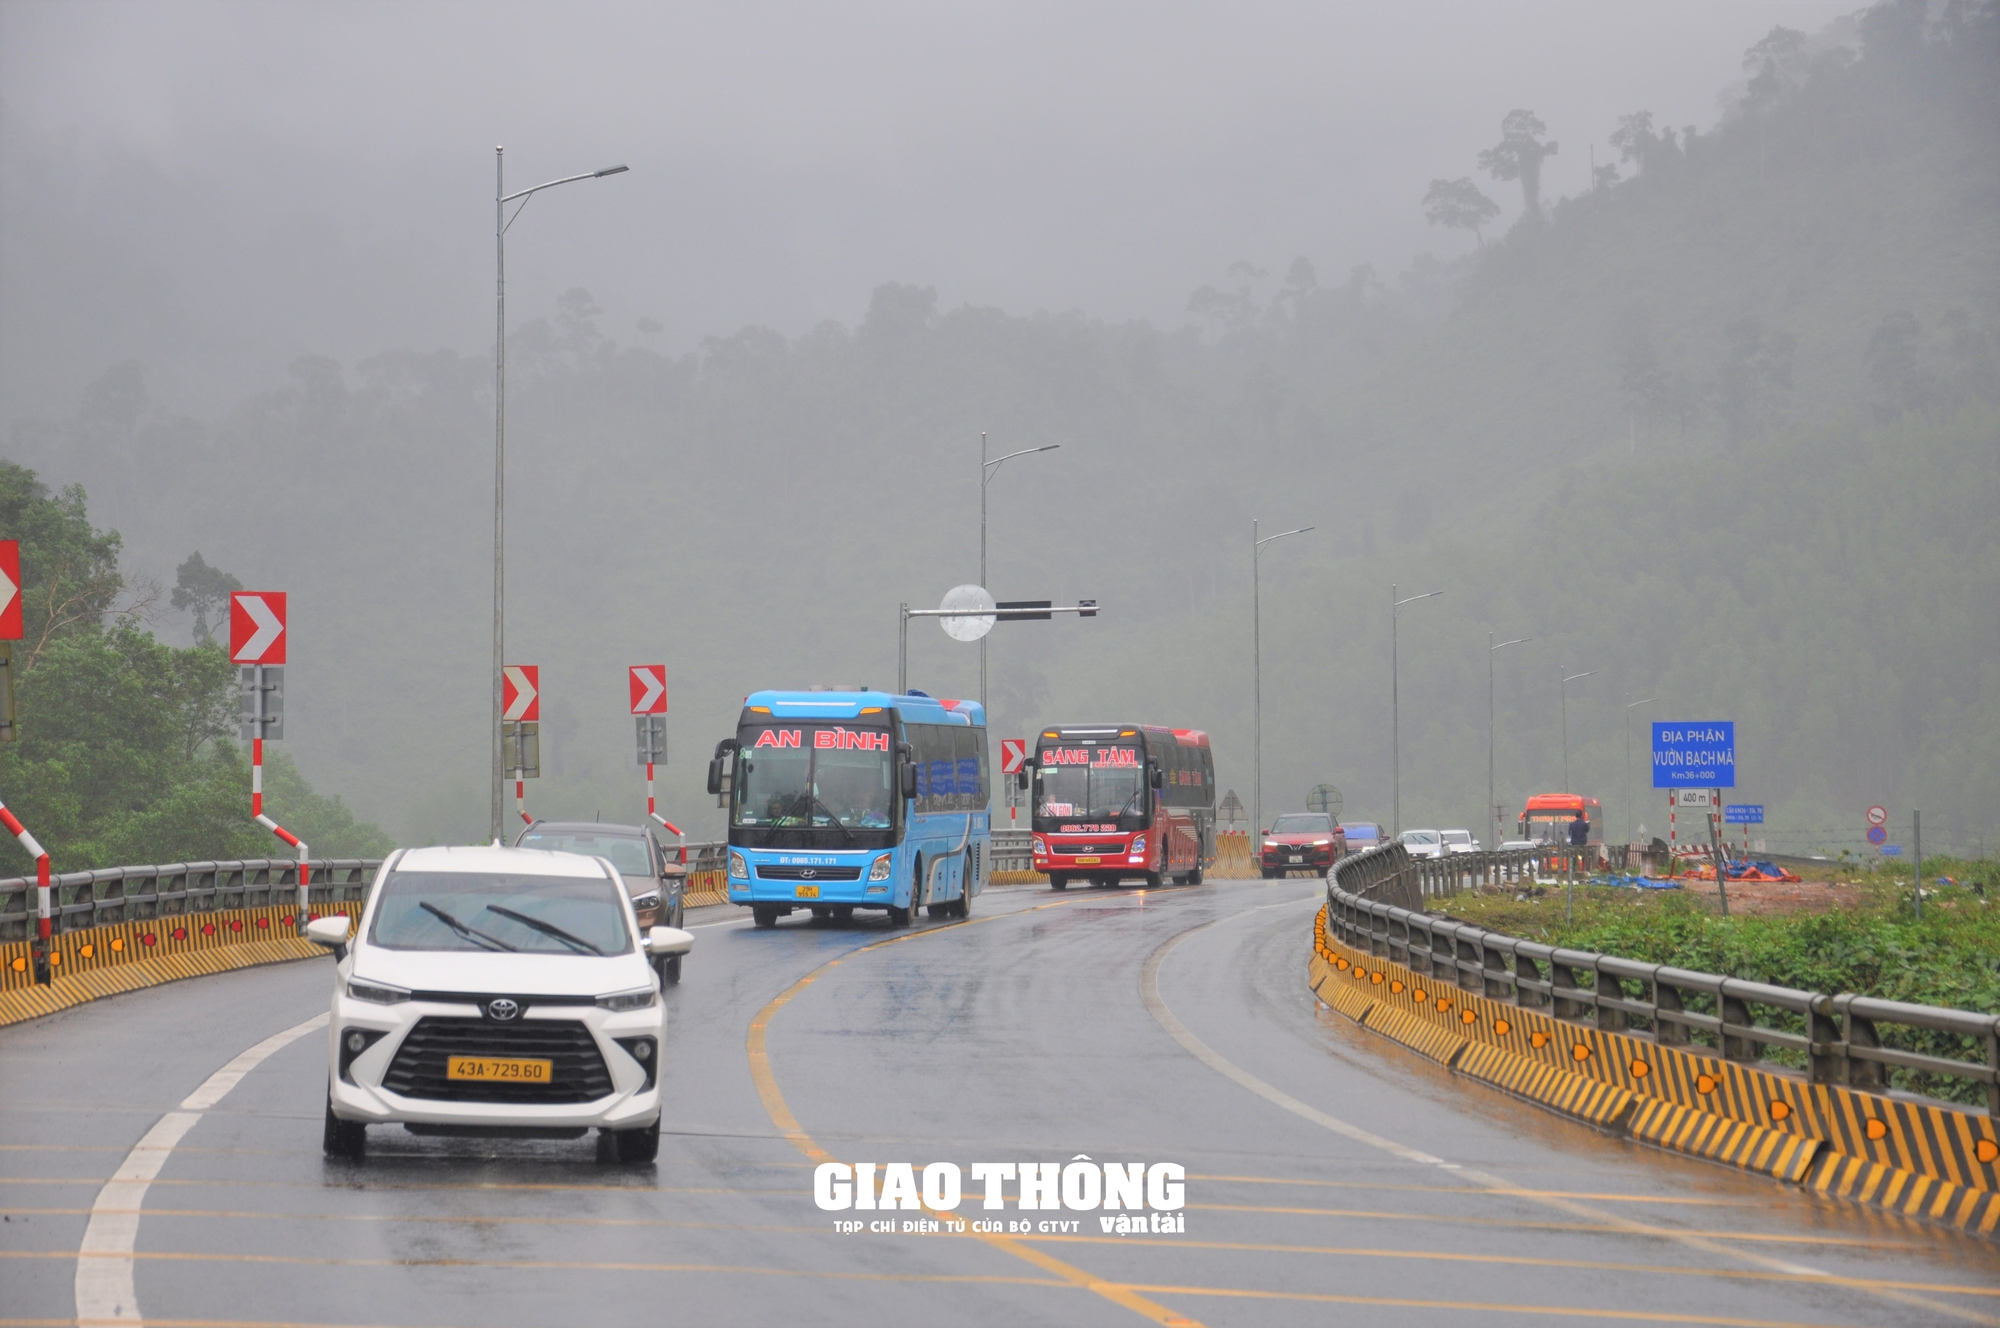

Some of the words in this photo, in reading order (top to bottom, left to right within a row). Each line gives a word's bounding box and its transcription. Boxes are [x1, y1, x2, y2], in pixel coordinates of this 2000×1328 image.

[754, 730, 802, 748] AN
[814, 726, 889, 751] BÌNH
[1662, 730, 1684, 744] ĐỊA
[1687, 728, 1725, 744] PHẬN
[1043, 746, 1089, 765] SÁNG
[1098, 746, 1135, 764] TÂM
[1653, 748, 1684, 766] VƯỜN
[1686, 750, 1716, 768] BẠCH
[1717, 748, 1734, 766] MÃ
[1671, 771, 1716, 780] Km36+000
[1683, 793, 1697, 802] 400
